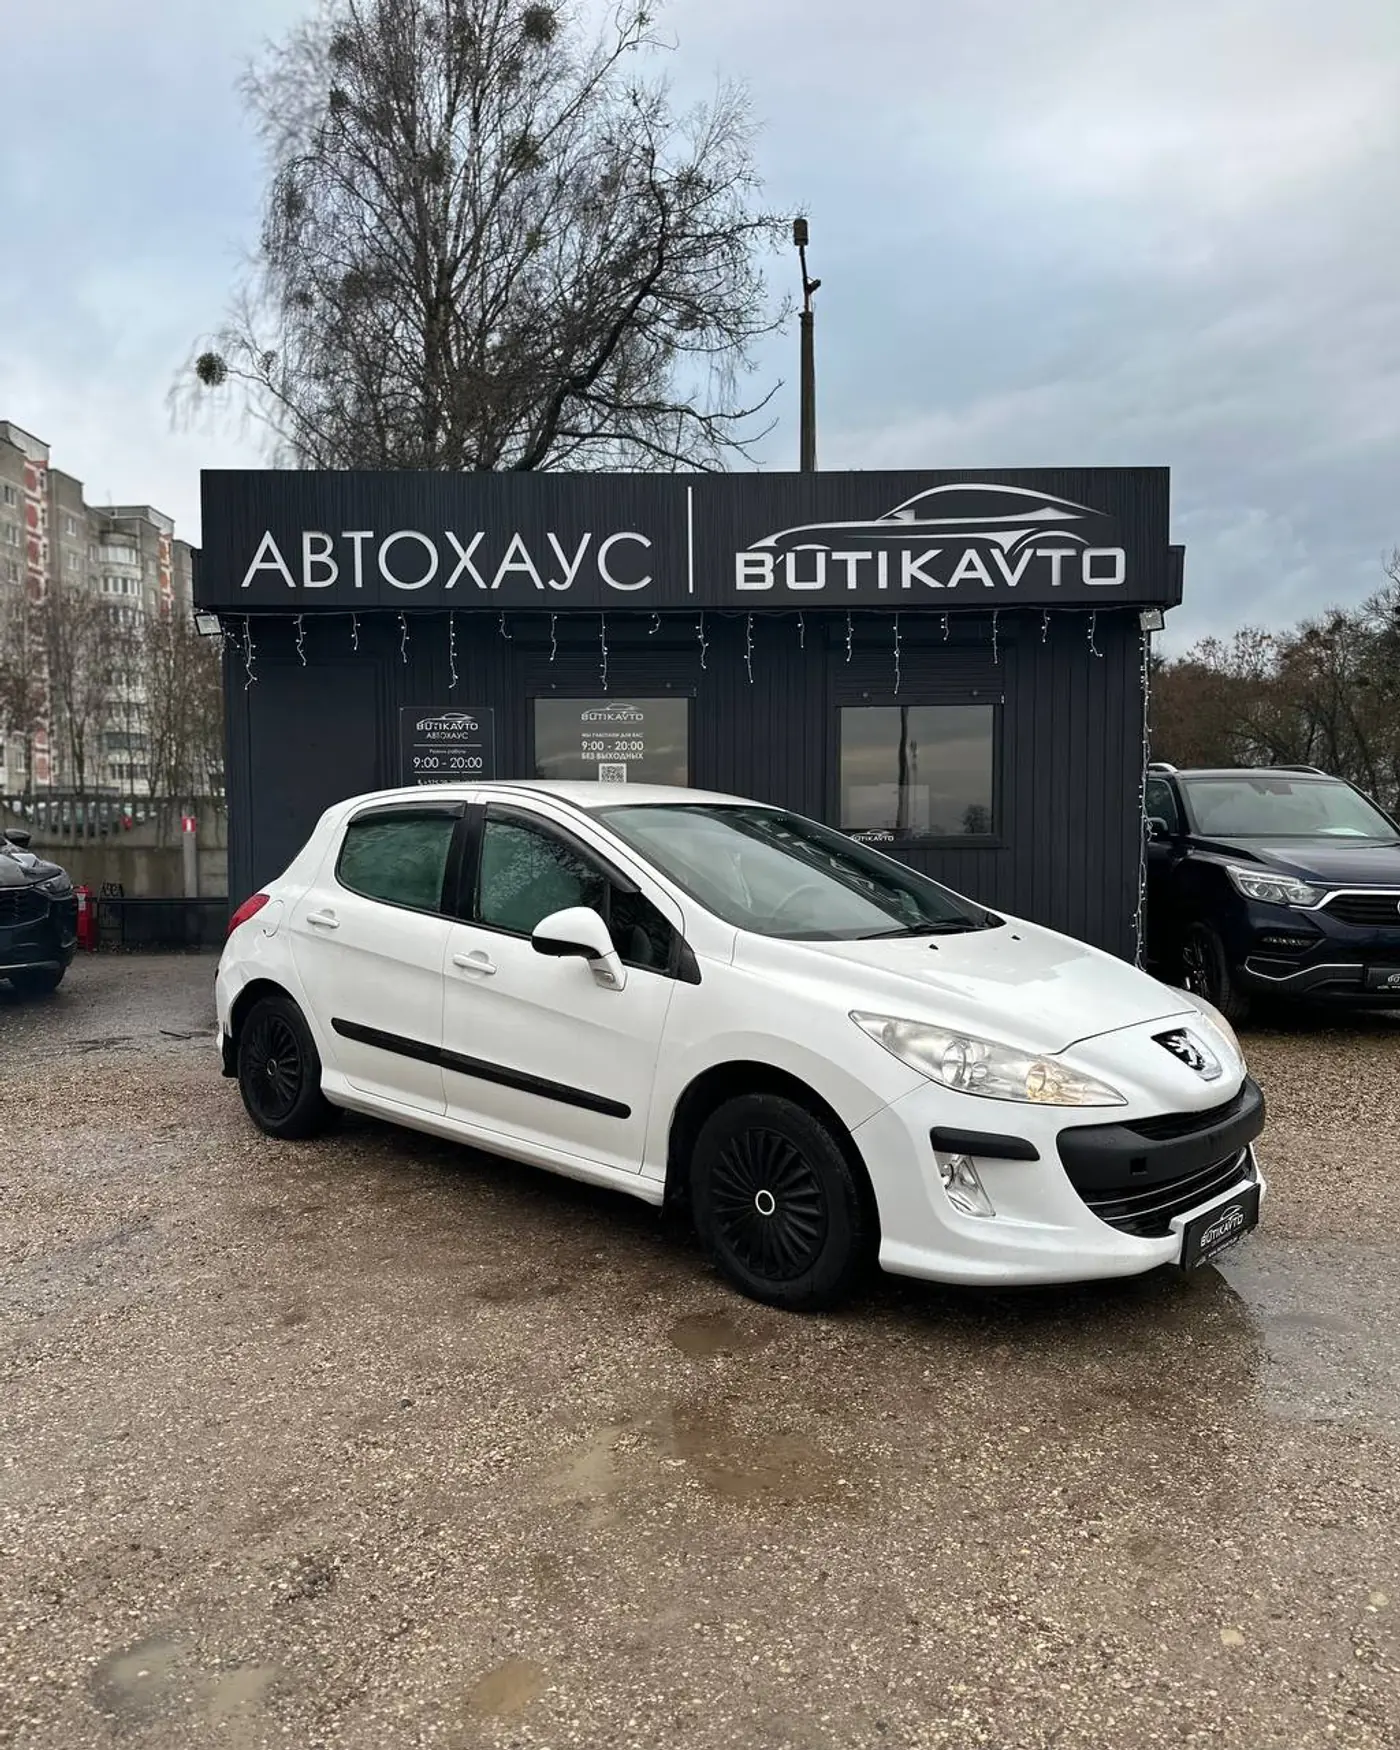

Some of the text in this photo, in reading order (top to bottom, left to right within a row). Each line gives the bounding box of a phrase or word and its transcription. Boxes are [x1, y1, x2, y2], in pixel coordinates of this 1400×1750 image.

[241, 529, 653, 591] АВТОХАУС
[735, 546, 1126, 590] BUTIKAVTO
[581, 740, 605, 751] 9:00
[615, 740, 644, 751] 20:00
[413, 756, 440, 769] 9:00
[450, 756, 483, 769] 20:00
[581, 752, 644, 760] БЕЗ ВЫХОДНЫХ
